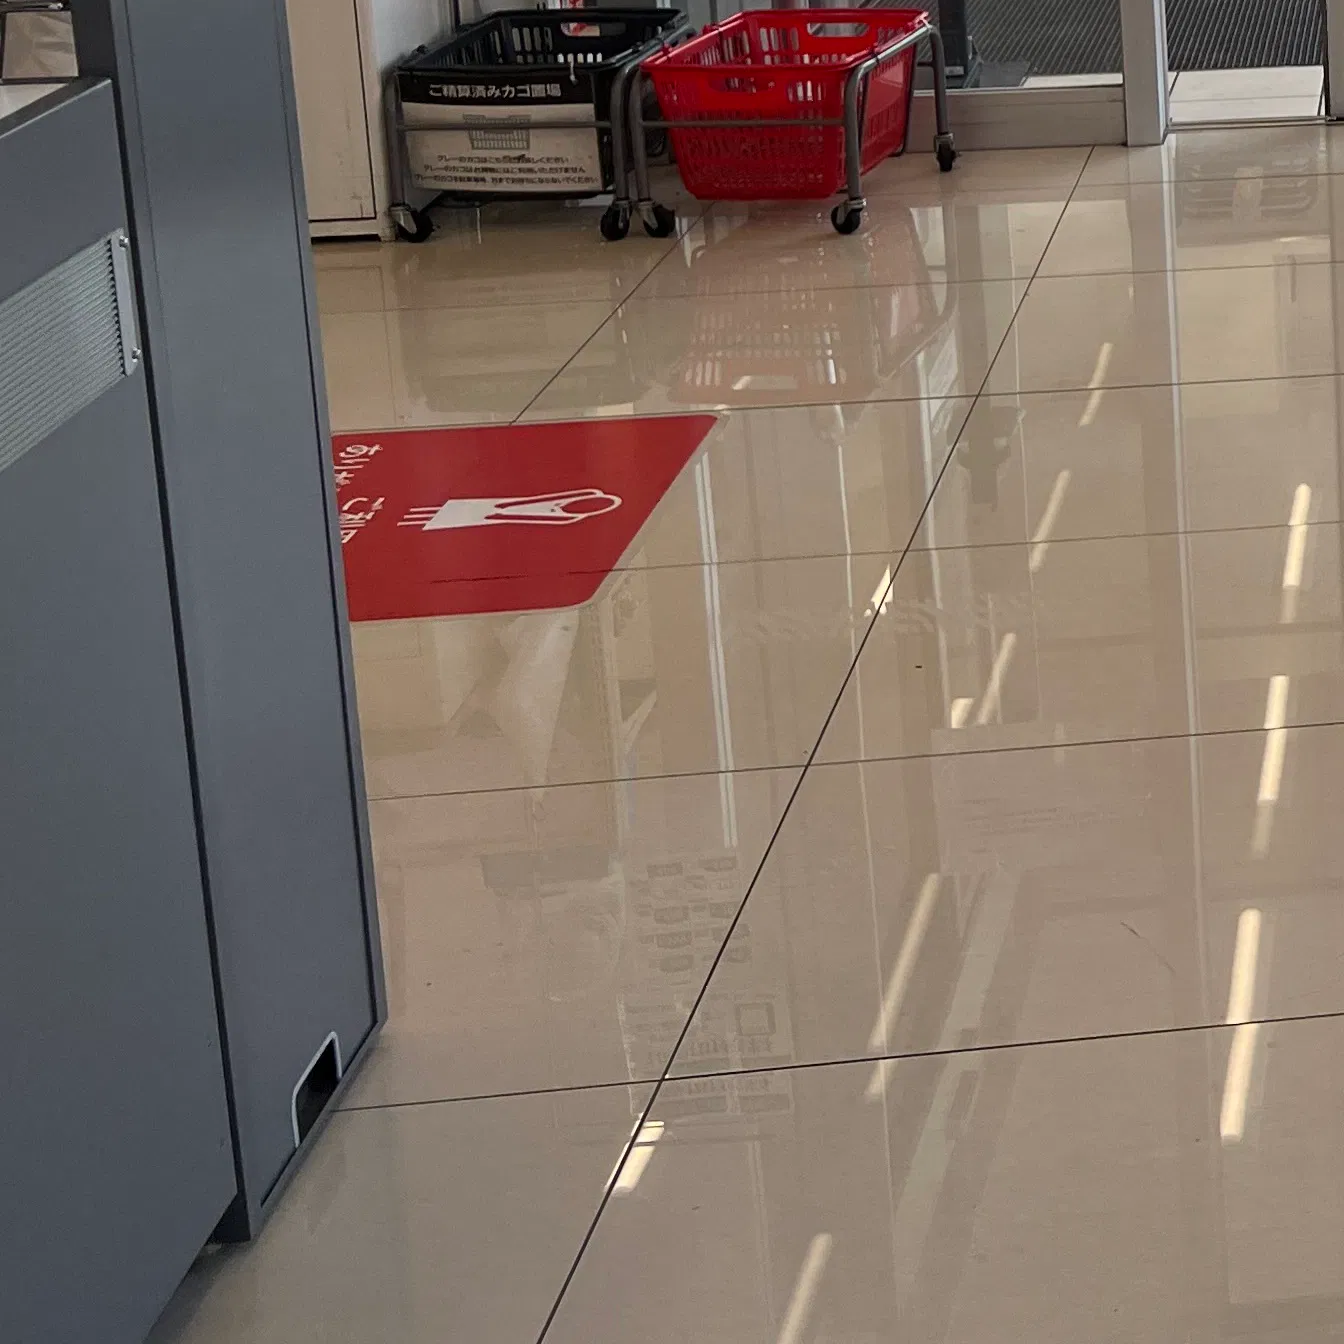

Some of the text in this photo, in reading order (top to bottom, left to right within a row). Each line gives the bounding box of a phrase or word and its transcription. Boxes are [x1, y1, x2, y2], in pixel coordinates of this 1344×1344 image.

[428, 83, 562, 99] ご精算済みカゴ置場
